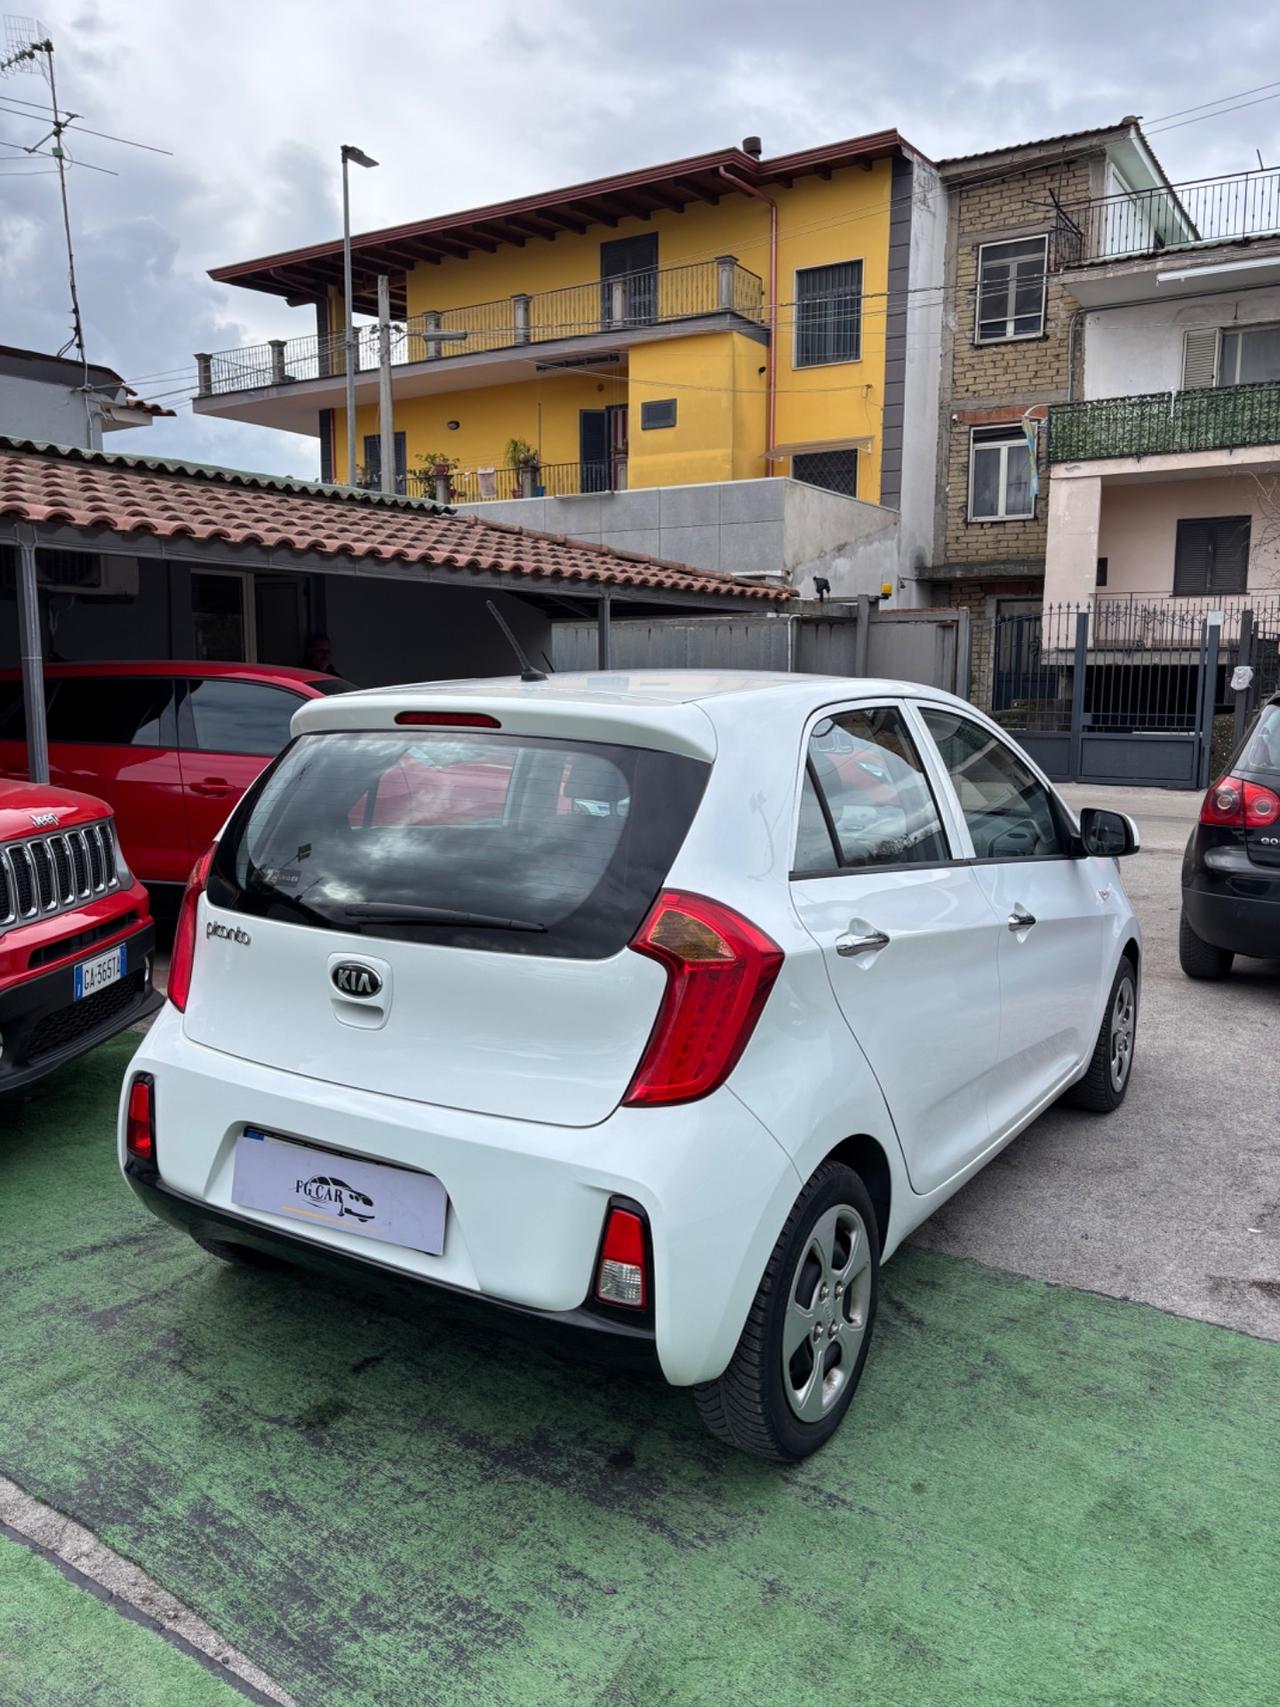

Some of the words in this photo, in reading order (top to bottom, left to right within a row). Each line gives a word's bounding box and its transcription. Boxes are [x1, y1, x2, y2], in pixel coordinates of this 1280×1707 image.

[29, 812, 59, 828] Jeep
[1260, 836, 1280, 846] GO
[206, 920, 251, 946] picanto
[337, 968, 373, 993] KIA
[315, 1184, 344, 1206] CAR
